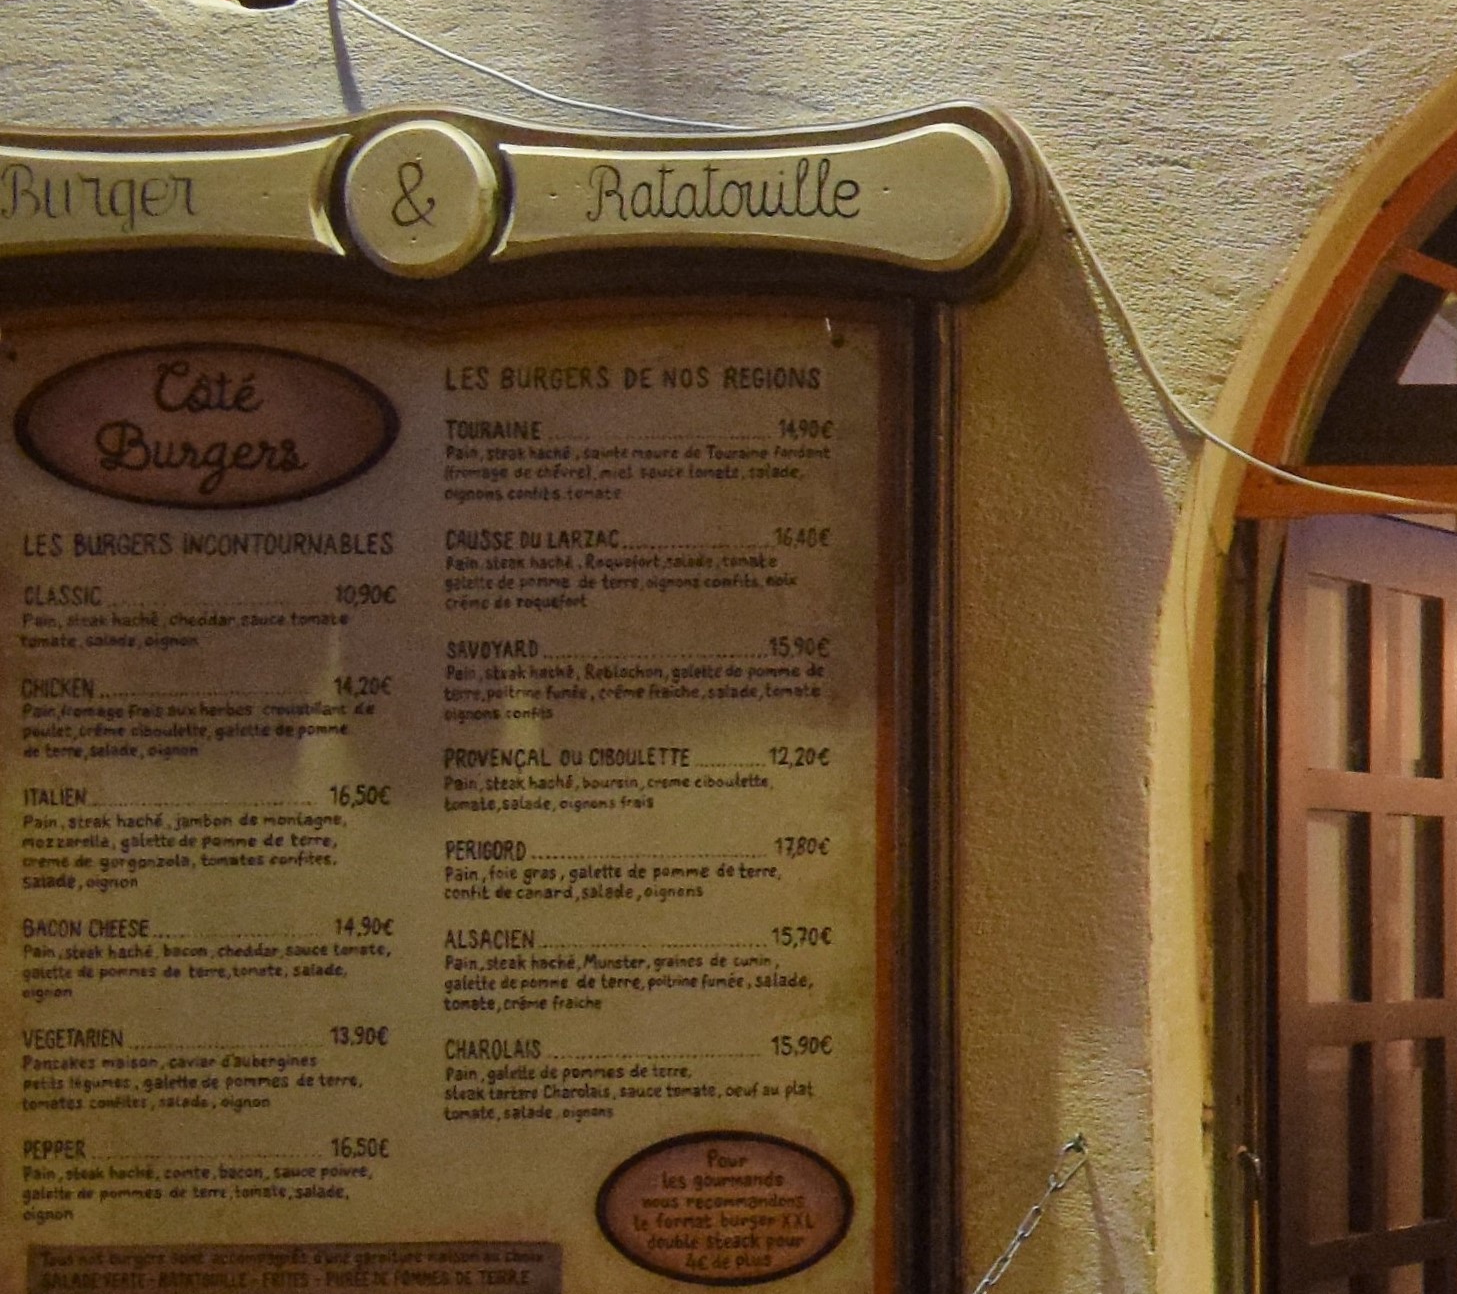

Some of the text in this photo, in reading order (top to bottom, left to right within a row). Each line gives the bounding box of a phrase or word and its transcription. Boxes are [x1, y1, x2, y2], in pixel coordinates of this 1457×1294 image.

[0, 156, 861, 235] Burger & Ratatouille
[154, 361, 264, 413] Côté
[444, 367, 821, 390] LES BURGERS DE NOS REGIONS
[445, 420, 542, 440] TOURAINE
[96, 419, 307, 495] Burgers
[23, 532, 393, 556] LES BURGERS INCONTOURNABLES
[445, 529, 513, 549] CAUSSE
[520, 529, 541, 548] DU
[548, 529, 619, 548] LARZAC
[24, 584, 396, 606] CLASSIC 10,90€
[446, 639, 539, 659] SAVOYARD
[21, 678, 392, 698] CHICKEN 14,20€
[443, 747, 830, 773] PROVENÇAL OU CIBOULETTE 12,20€
[23, 785, 391, 808] ITALIEN 16,50€
[444, 838, 830, 861] PERIGORD 17,80€
[489, 865, 518, 881] foie
[569, 864, 622, 882] galette
[628, 865, 646, 879] de
[653, 865, 710, 882] pomme
[716, 863, 735, 877] de
[739, 864, 781, 880] terre,
[23, 919, 81, 938] BACON
[89, 919, 149, 938] CHEESE
[444, 927, 832, 949] ALSACIEN 15,70€
[23, 1029, 123, 1049] VEGETARIEN
[444, 1039, 541, 1059] CHAROLAIS
[23, 1138, 389, 1160] PEPPER 16,50€
